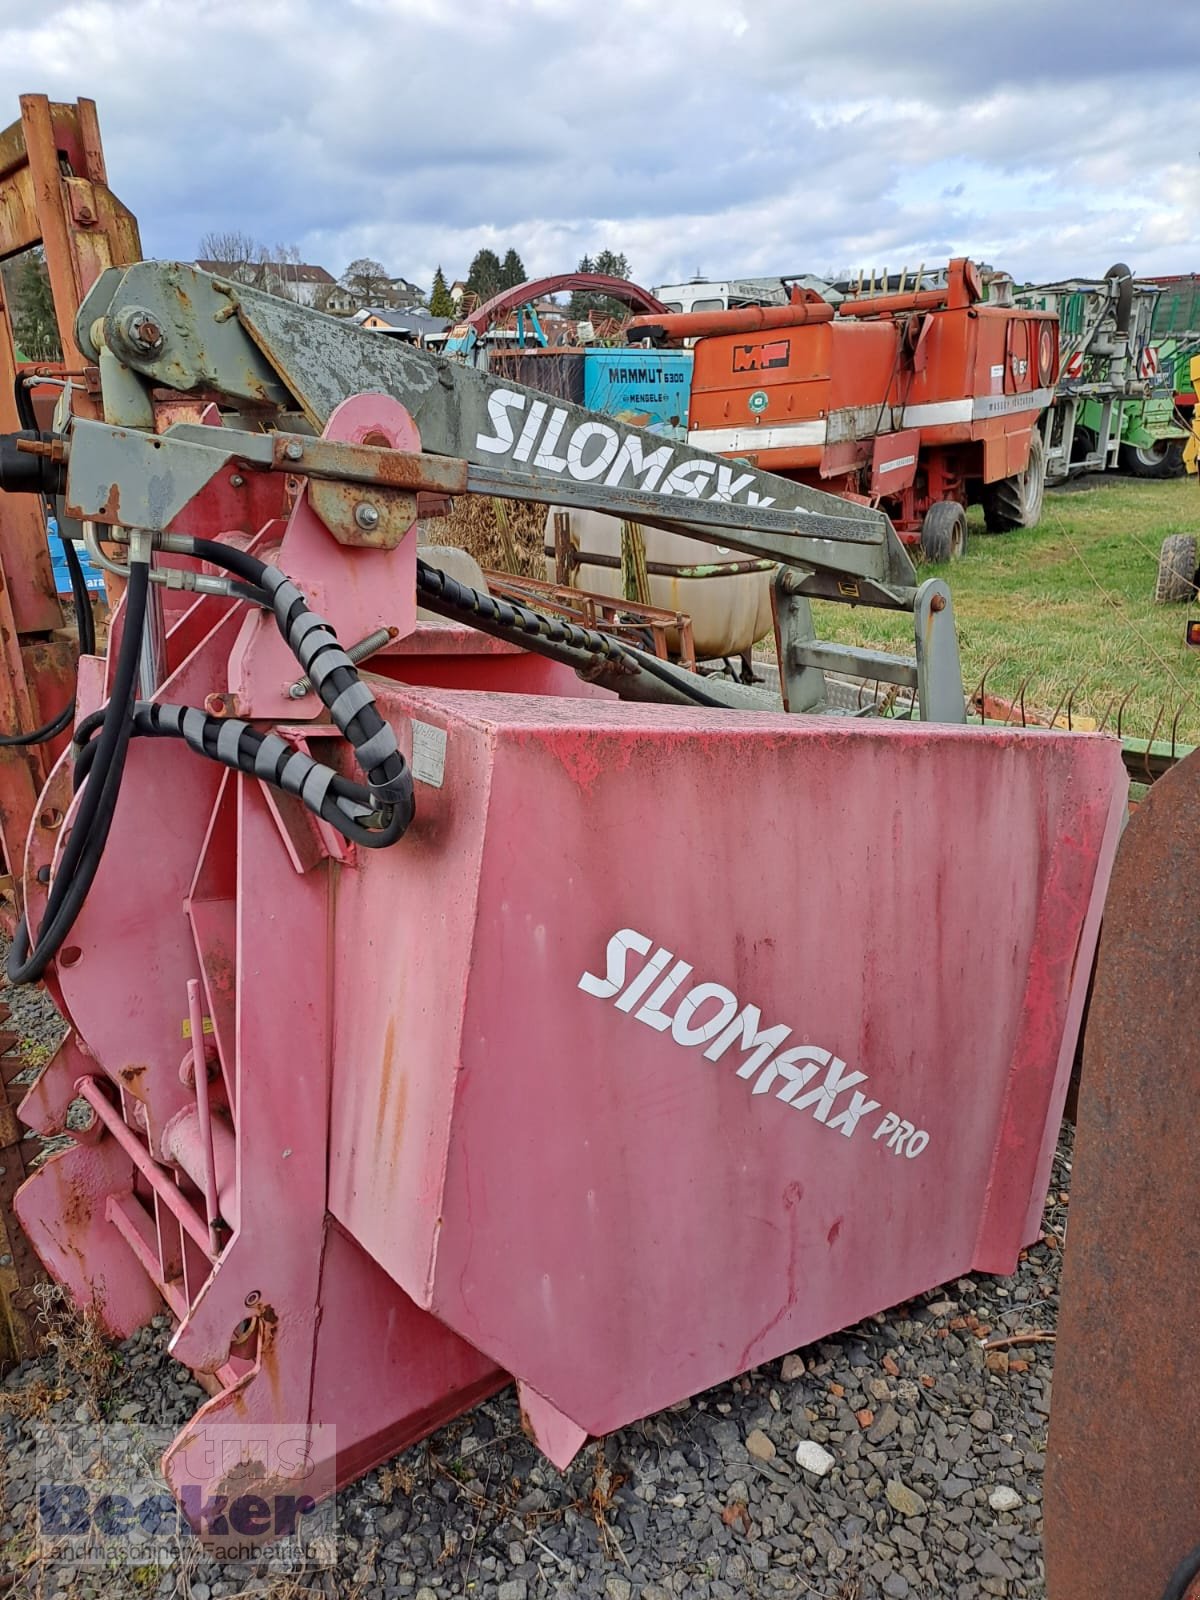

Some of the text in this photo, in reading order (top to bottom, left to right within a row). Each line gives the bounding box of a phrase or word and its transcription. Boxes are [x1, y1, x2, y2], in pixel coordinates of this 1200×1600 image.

[608, 367, 685, 384] MAMMUT 6300
[629, 393, 663, 404] MENGELE
[577, 927, 930, 1159] SILOMAXX PRO
